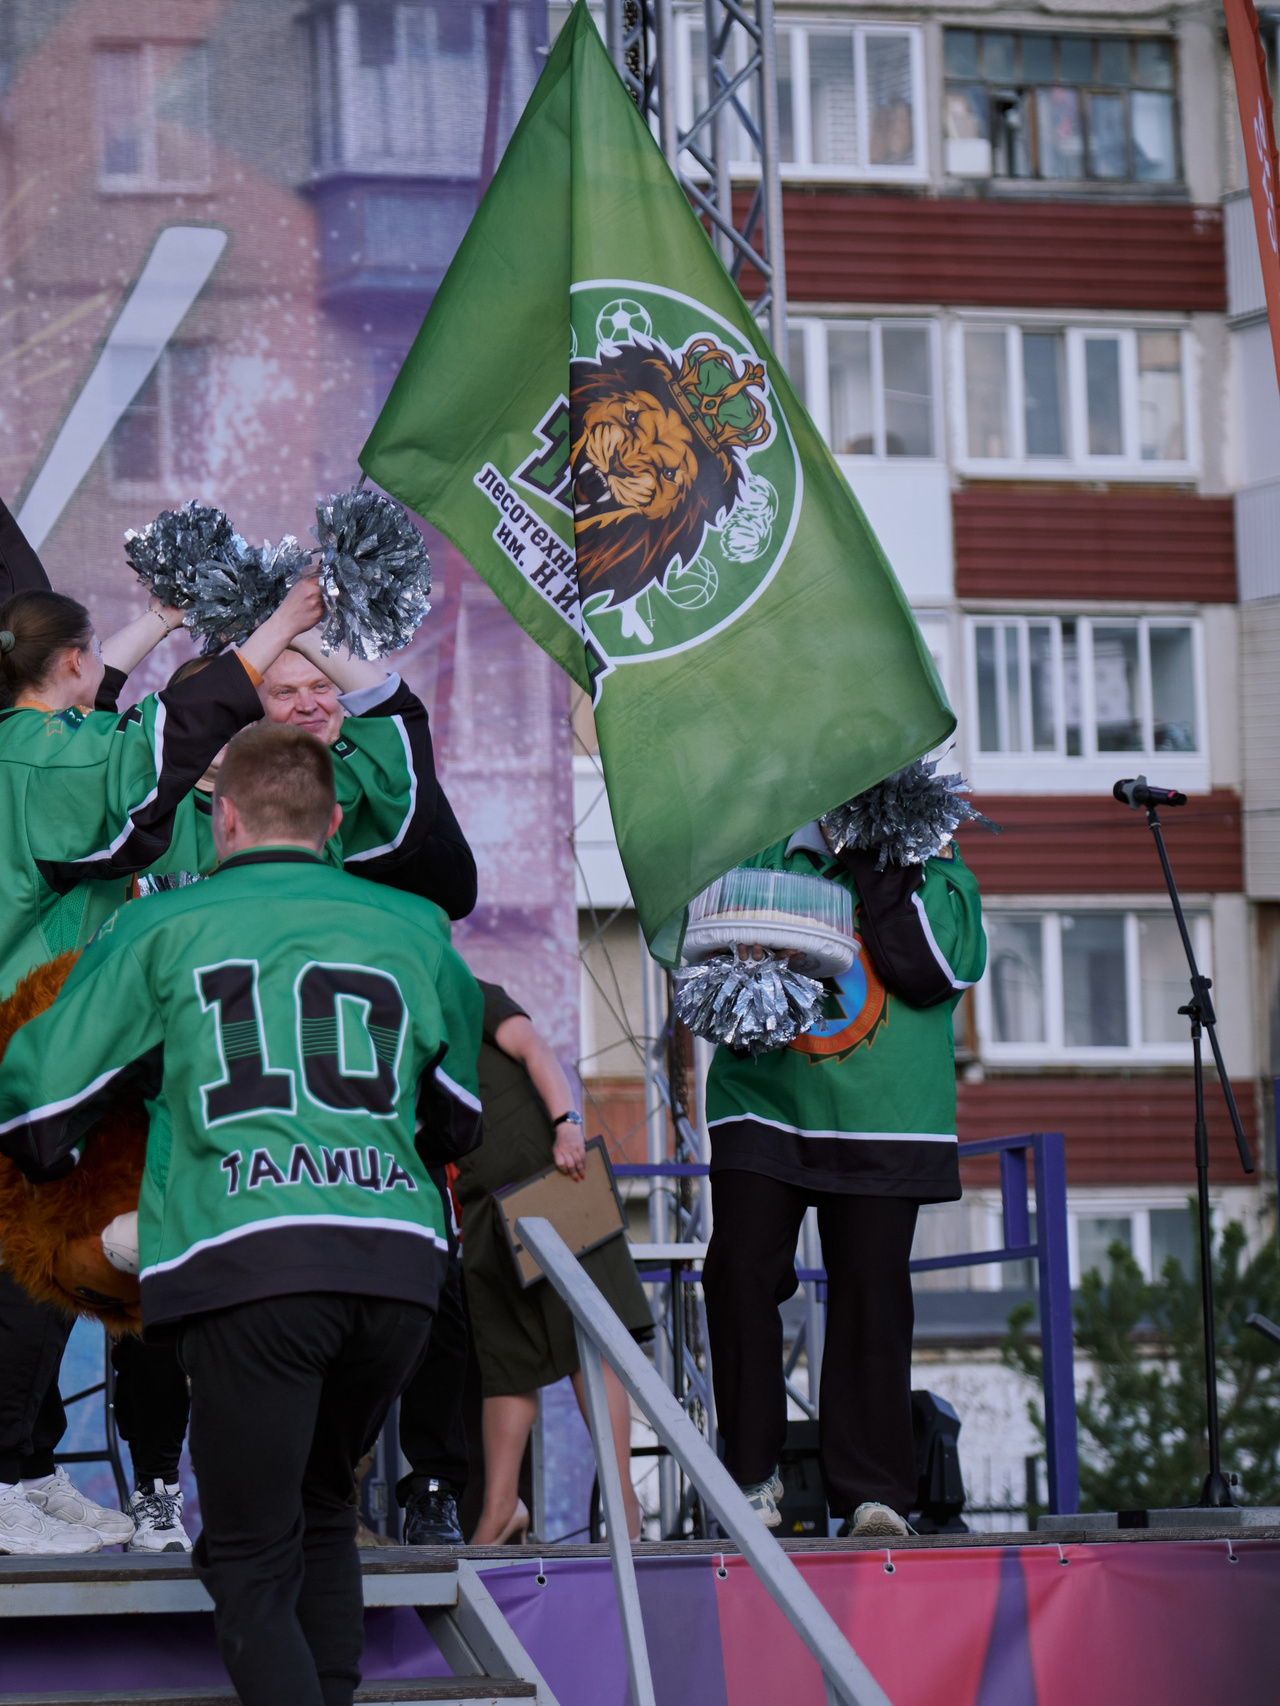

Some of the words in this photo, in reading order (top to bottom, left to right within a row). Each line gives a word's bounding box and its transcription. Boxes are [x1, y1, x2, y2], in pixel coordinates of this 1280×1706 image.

[497, 522, 523, 567] им.
[194, 959, 410, 1129] 10
[220, 1143, 418, 1193] ТАЛИЦА
